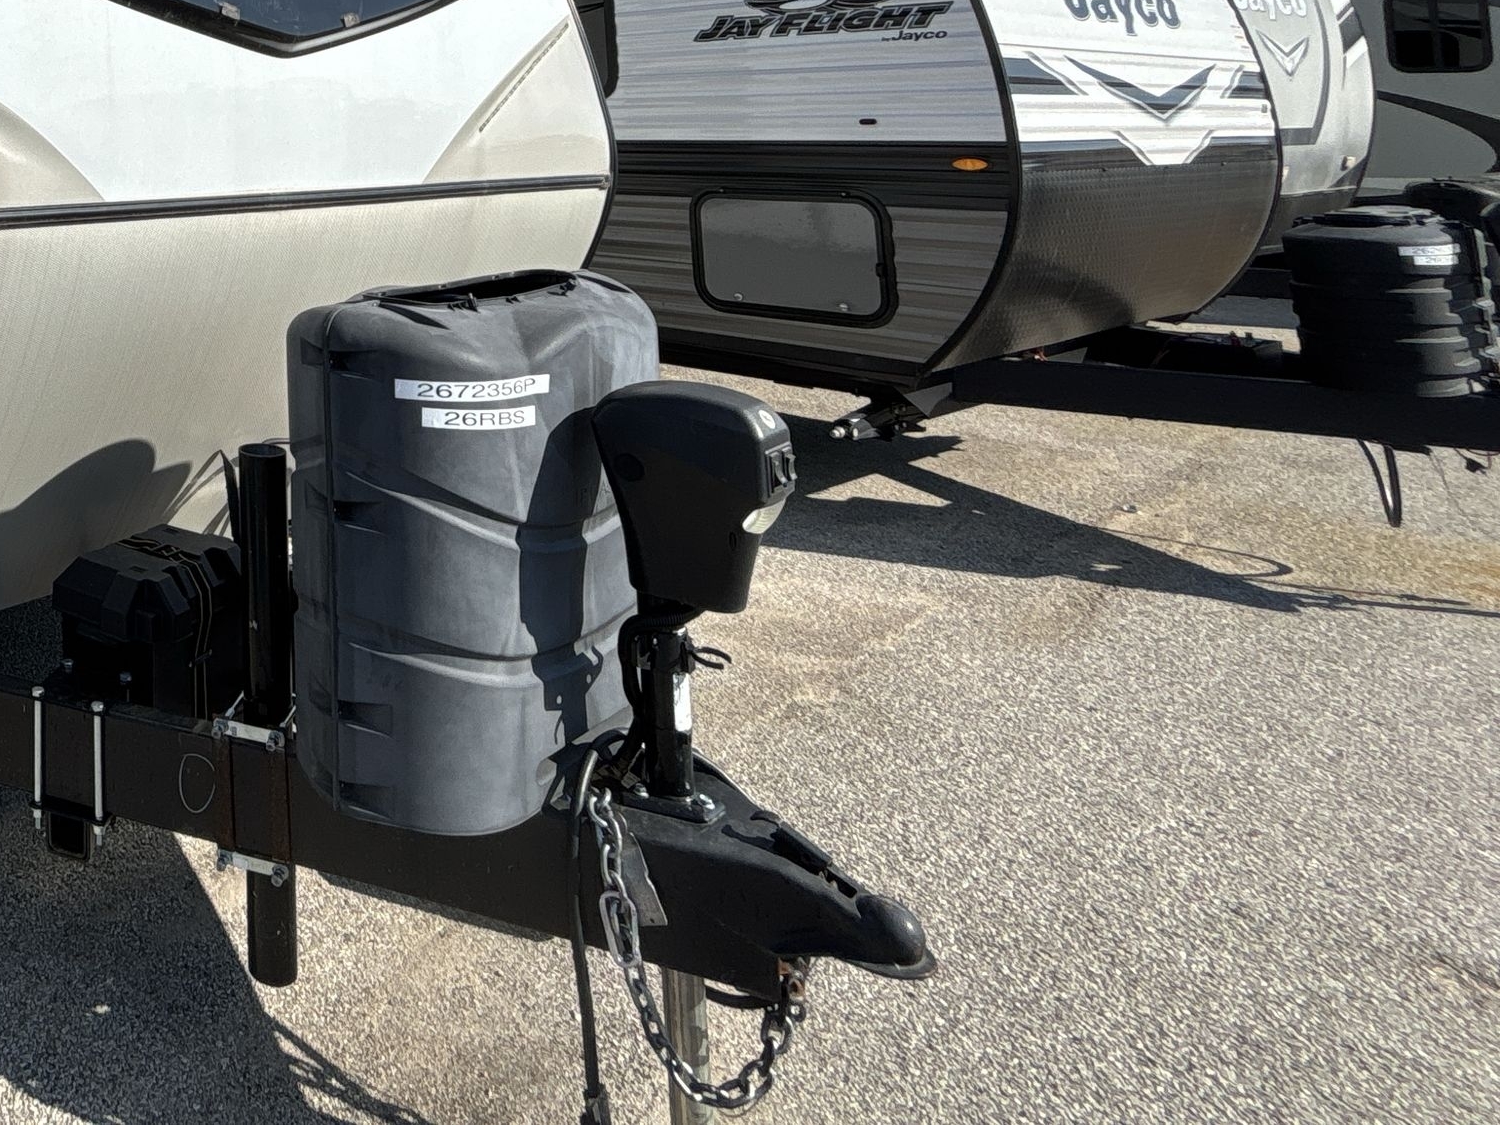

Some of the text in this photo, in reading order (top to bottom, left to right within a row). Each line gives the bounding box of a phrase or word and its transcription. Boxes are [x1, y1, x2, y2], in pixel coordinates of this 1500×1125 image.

[693, 1, 954, 42] JAY FLIGHT
[891, 30, 947, 41] Jayco
[417, 377, 536, 399] 2672356P
[444, 410, 525, 427] 26RBS
